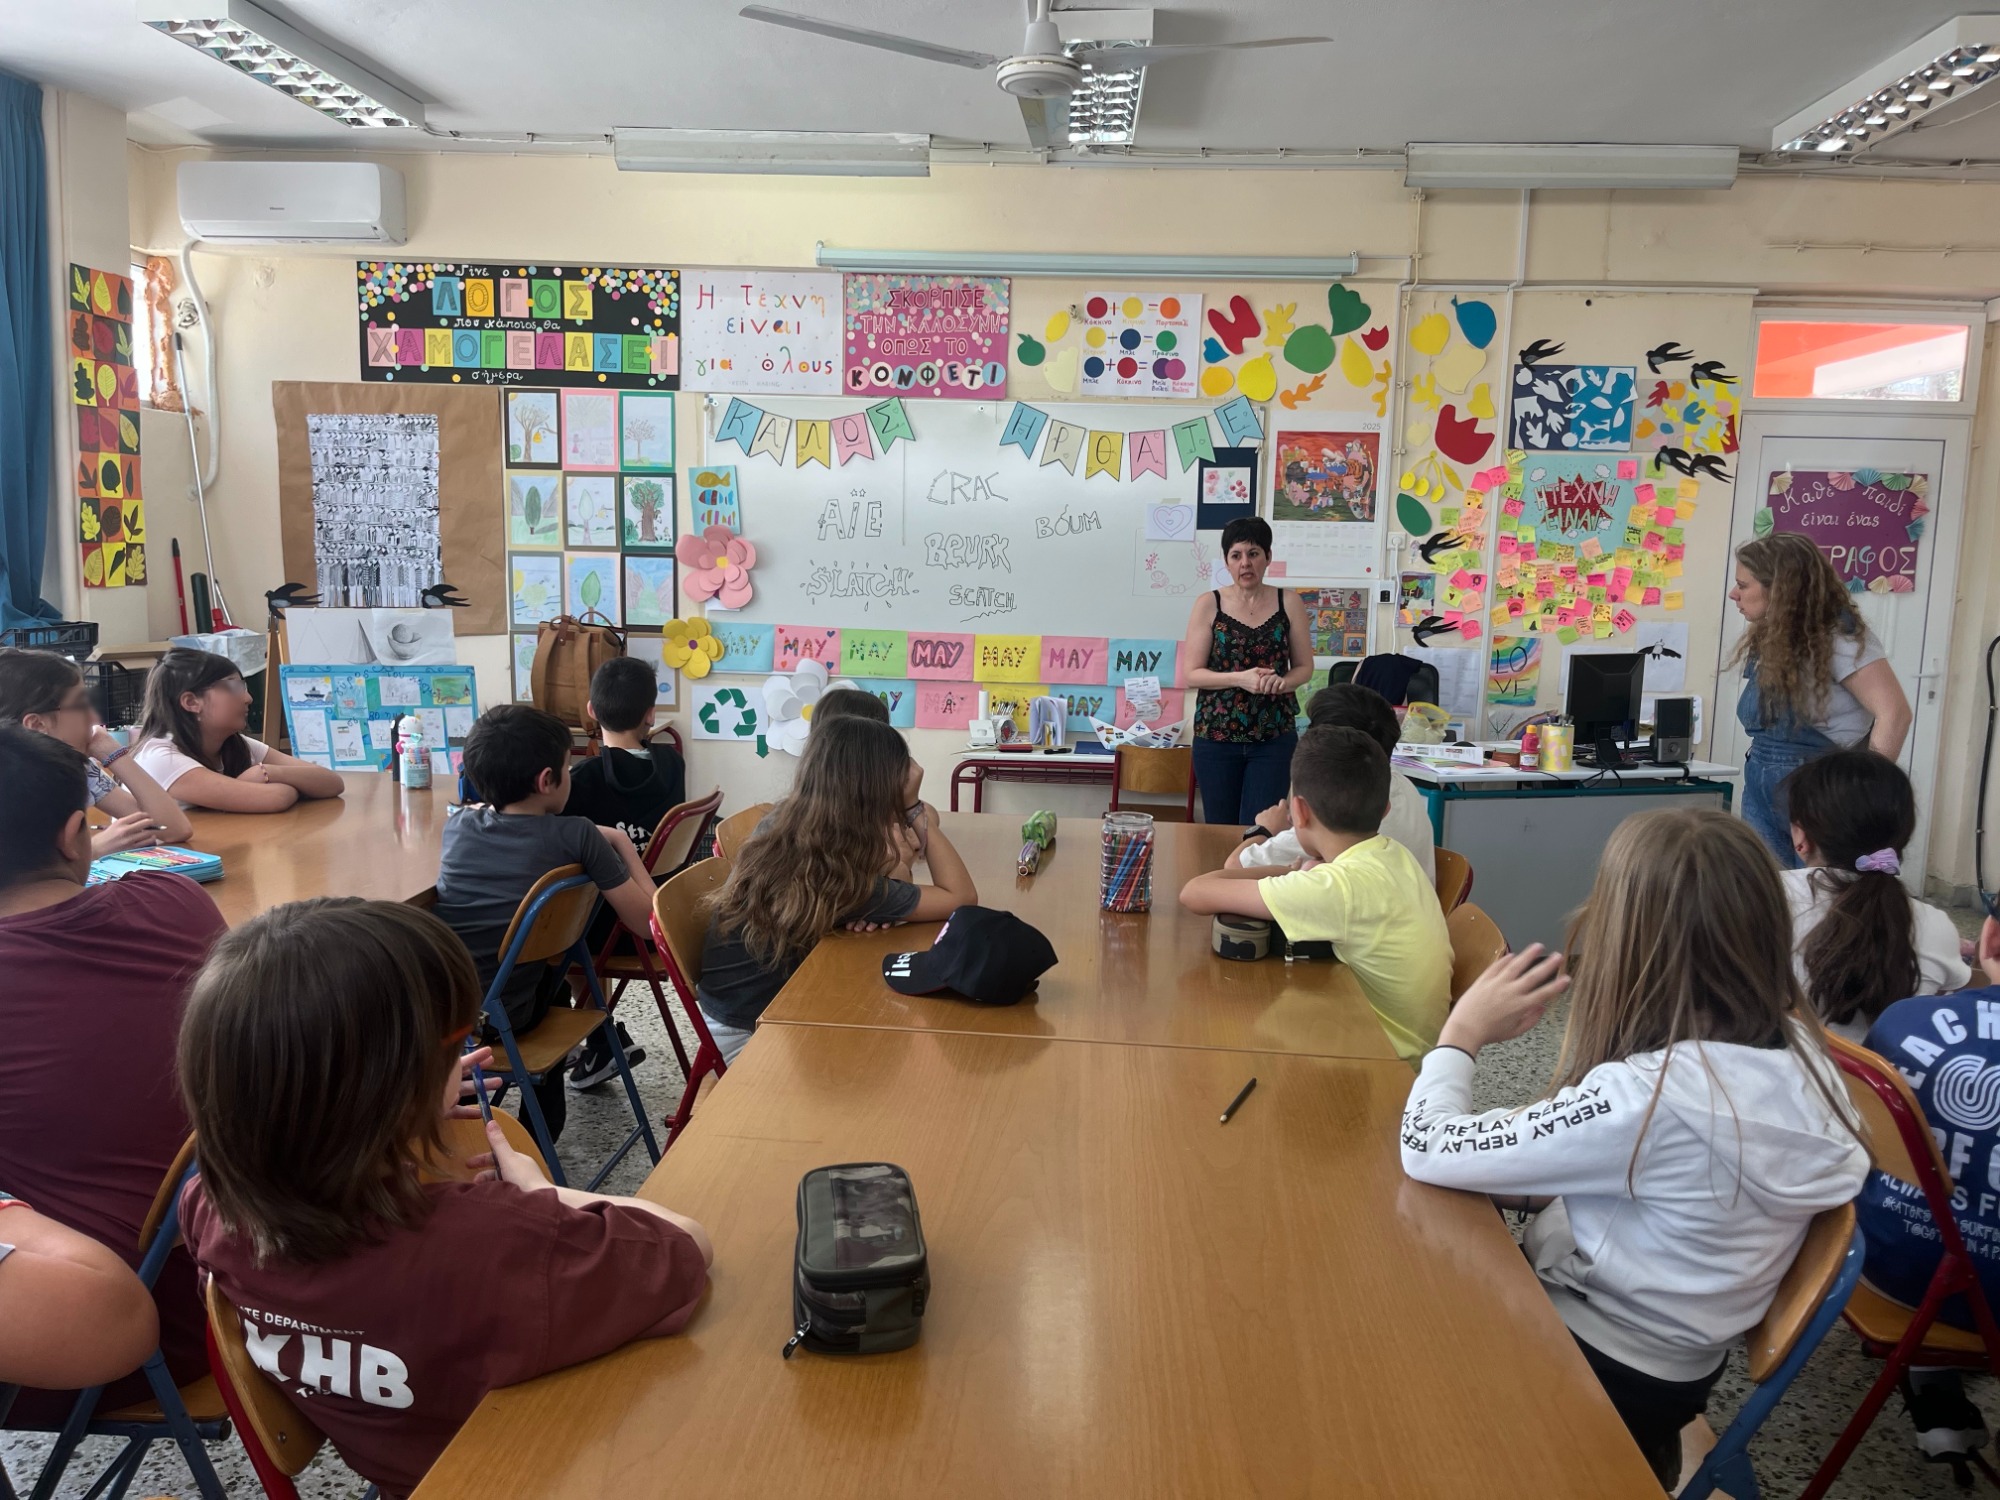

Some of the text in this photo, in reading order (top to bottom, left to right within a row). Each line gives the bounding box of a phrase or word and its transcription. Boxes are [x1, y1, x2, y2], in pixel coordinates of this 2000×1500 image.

[455, 264, 510, 277] Γίνε ο
[436, 281, 589, 317] ΛΟΓΟΣ
[696, 284, 825, 318] Η Τέχνη
[886, 288, 986, 310] ΣΚΟΡΠΙΣΕ
[454, 318, 561, 330] που κάποιος θα
[726, 317, 801, 335] είναι
[859, 314, 1001, 334] ΤΗΝ ΚΑΛΟΣΥΝΗ
[370, 332, 672, 374] ΧΑΜΟΓΕΛΑΣΕΙ
[943, 337, 968, 356] ΤΟ
[471, 369, 523, 385] σήμερα
[695, 358, 733, 377] για
[850, 361, 999, 389] ΚΟΝΦΕΤΙ
[1011, 403, 1252, 466] ΗΡΘΑΤΕ
[1362, 422, 1382, 431] 2025
[927, 469, 1009, 505] CRAC
[1780, 481, 1907, 516] Κάθε παιδί
[1544, 507, 1601, 531] ΕΙΝΑΙ
[1801, 512, 1880, 527] είναι ένας
[1817, 545, 1916, 576] ΡΑΦΟΣ
[948, 584, 1016, 608] SCATCH
[783, 636, 827, 658] MAY
[850, 640, 893, 661] MAY
[911, 640, 964, 668] MAY
[983, 645, 1027, 668] MAY
[1049, 647, 1094, 669] MAY
[1115, 650, 1162, 672] MAY
[1528, 1086, 1601, 1121] REPLAY
[1532, 1099, 1612, 1140] REPLAY
[1440, 1132, 1518, 1154] REPLAY
